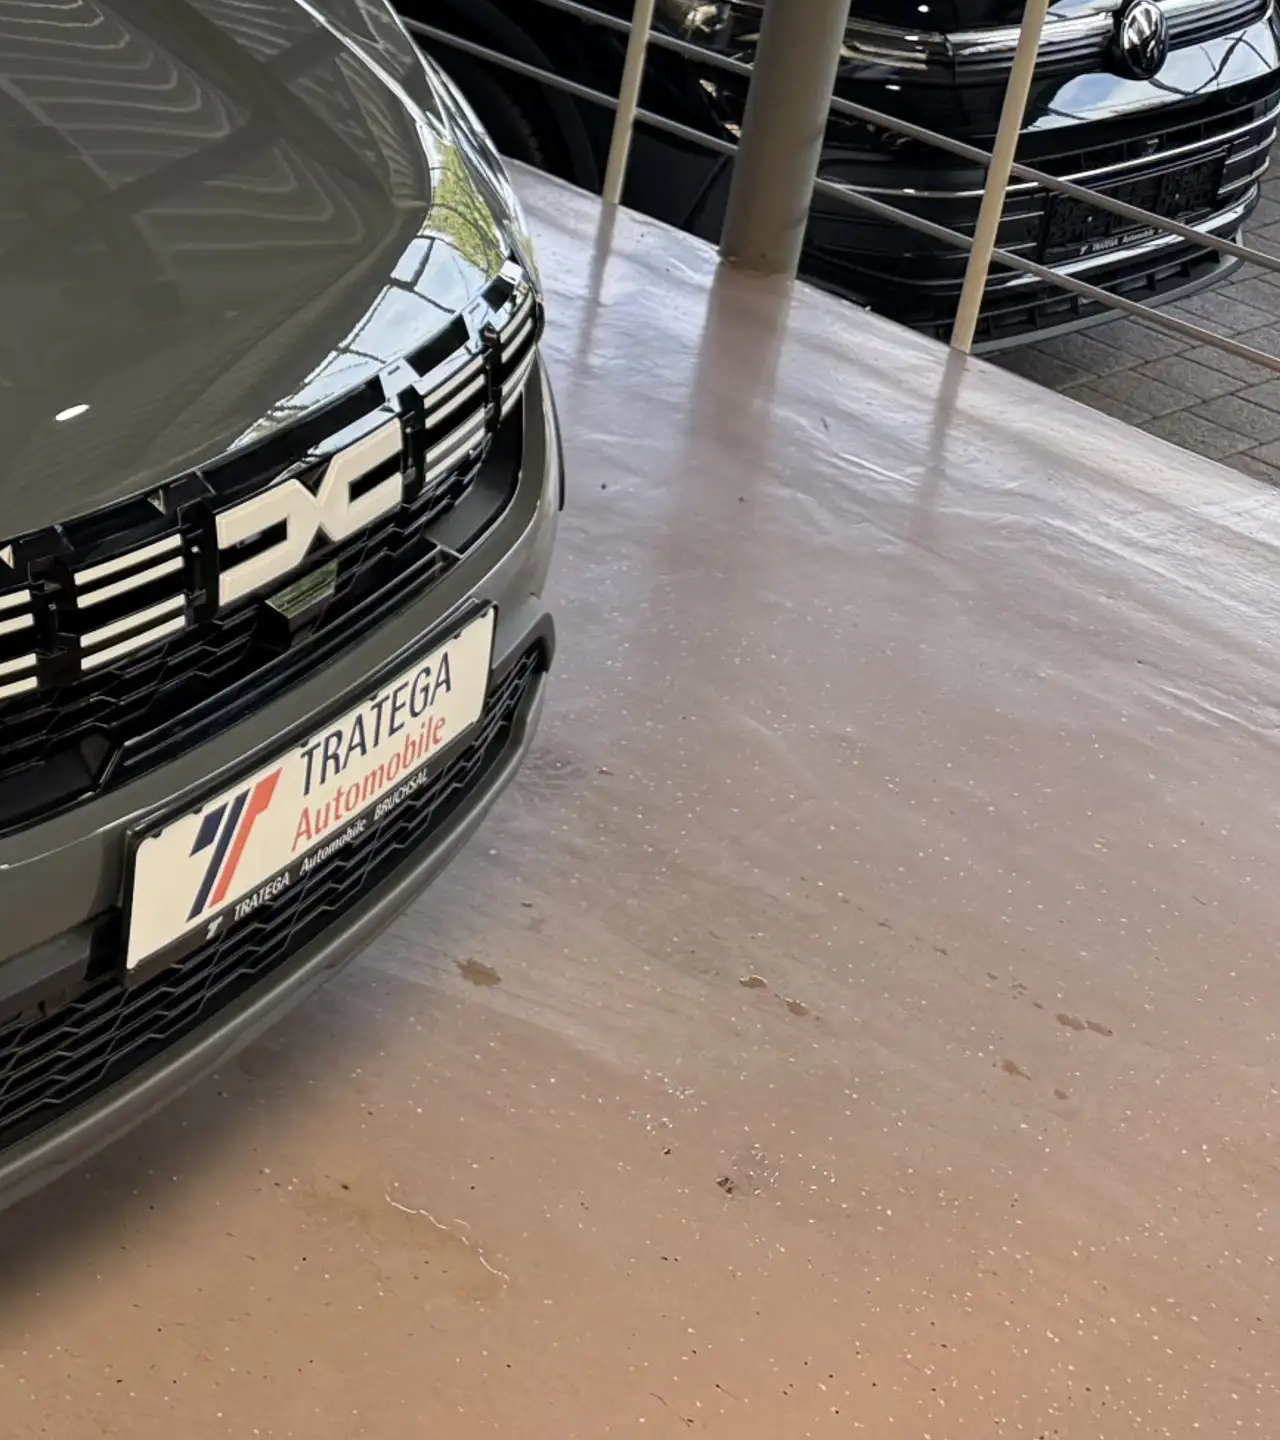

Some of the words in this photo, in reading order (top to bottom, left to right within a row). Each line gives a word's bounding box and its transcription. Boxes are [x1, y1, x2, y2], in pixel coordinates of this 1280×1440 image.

[291, 716, 446, 853] Automobile
[300, 651, 452, 796] TRATEGA
[234, 871, 290, 922] TRATEGA
[299, 818, 367, 876] Automobile
[373, 768, 429, 821] BRUCHSAL
